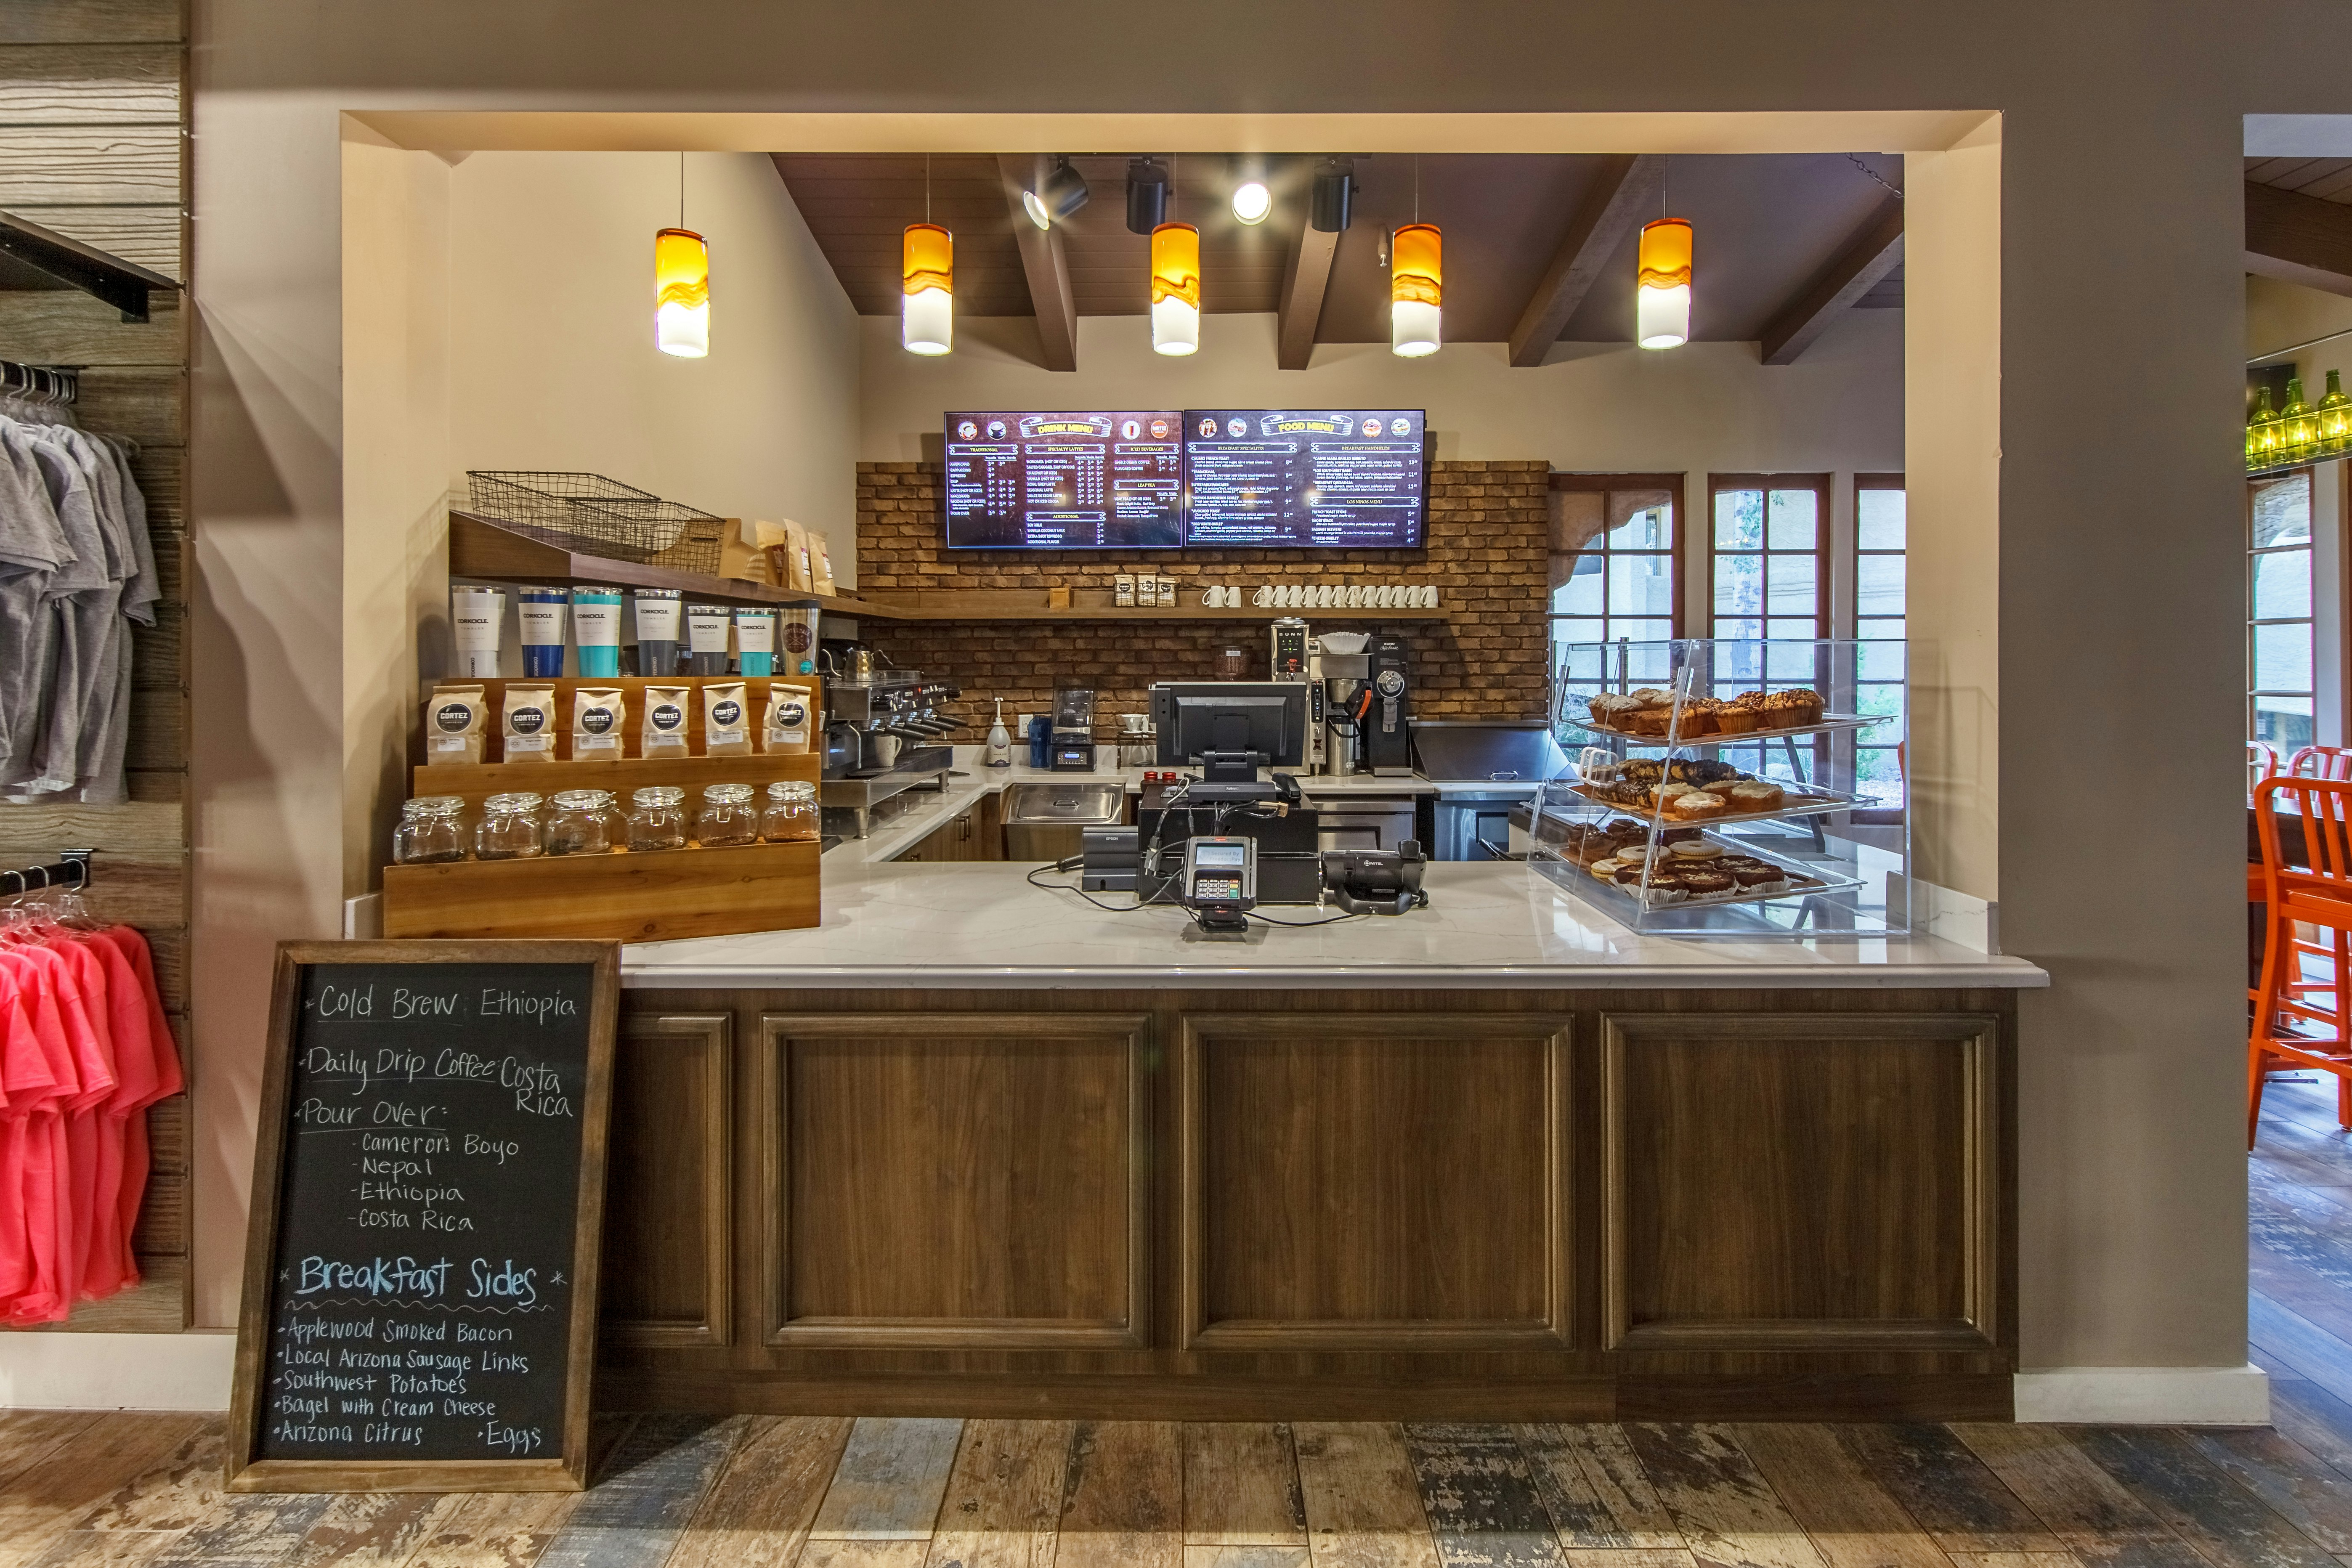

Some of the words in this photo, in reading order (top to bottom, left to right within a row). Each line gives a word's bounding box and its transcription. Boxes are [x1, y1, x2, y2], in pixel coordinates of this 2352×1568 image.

[1038, 424, 1067, 434] DRINK
[1068, 424, 1094, 434] MENU
[1278, 422, 1306, 432] FOOD
[1307, 422, 1334, 432] MENU
[320, 984, 372, 1018] Cold
[481, 989, 576, 1025] Ethiopia
[308, 1047, 366, 1095] Daily
[377, 1048, 425, 1082] Drip
[501, 1057, 560, 1093] Costa
[303, 1098, 361, 1124] Pour
[517, 1089, 573, 1117] Rica
[465, 1135, 518, 1165] Boyo
[363, 1157, 432, 1183] Nepal
[361, 1181, 464, 1207] Ethiopia
[360, 1209, 409, 1228] Costa
[422, 1210, 473, 1231] Rica
[295, 1256, 454, 1298] Breakfast
[467, 1258, 536, 1306] Sides
[289, 1317, 374, 1344] Applewood
[383, 1320, 445, 1342] Smoked
[457, 1323, 512, 1342] Bacon
[285, 1344, 329, 1365] Local
[339, 1349, 401, 1368] Arizona
[407, 1350, 471, 1379] Sausage
[483, 1351, 528, 1373] Links
[284, 1370, 377, 1391] Southwest
[391, 1374, 467, 1393] Potatoes
[283, 1395, 329, 1422] Bagel
[342, 1398, 374, 1414] with
[382, 1398, 433, 1417] Cream
[444, 1398, 496, 1416] Cheese
[280, 1420, 352, 1442] Arizona
[365, 1424, 423, 1445] Citrus
[487, 1420, 542, 1454] Eggs
